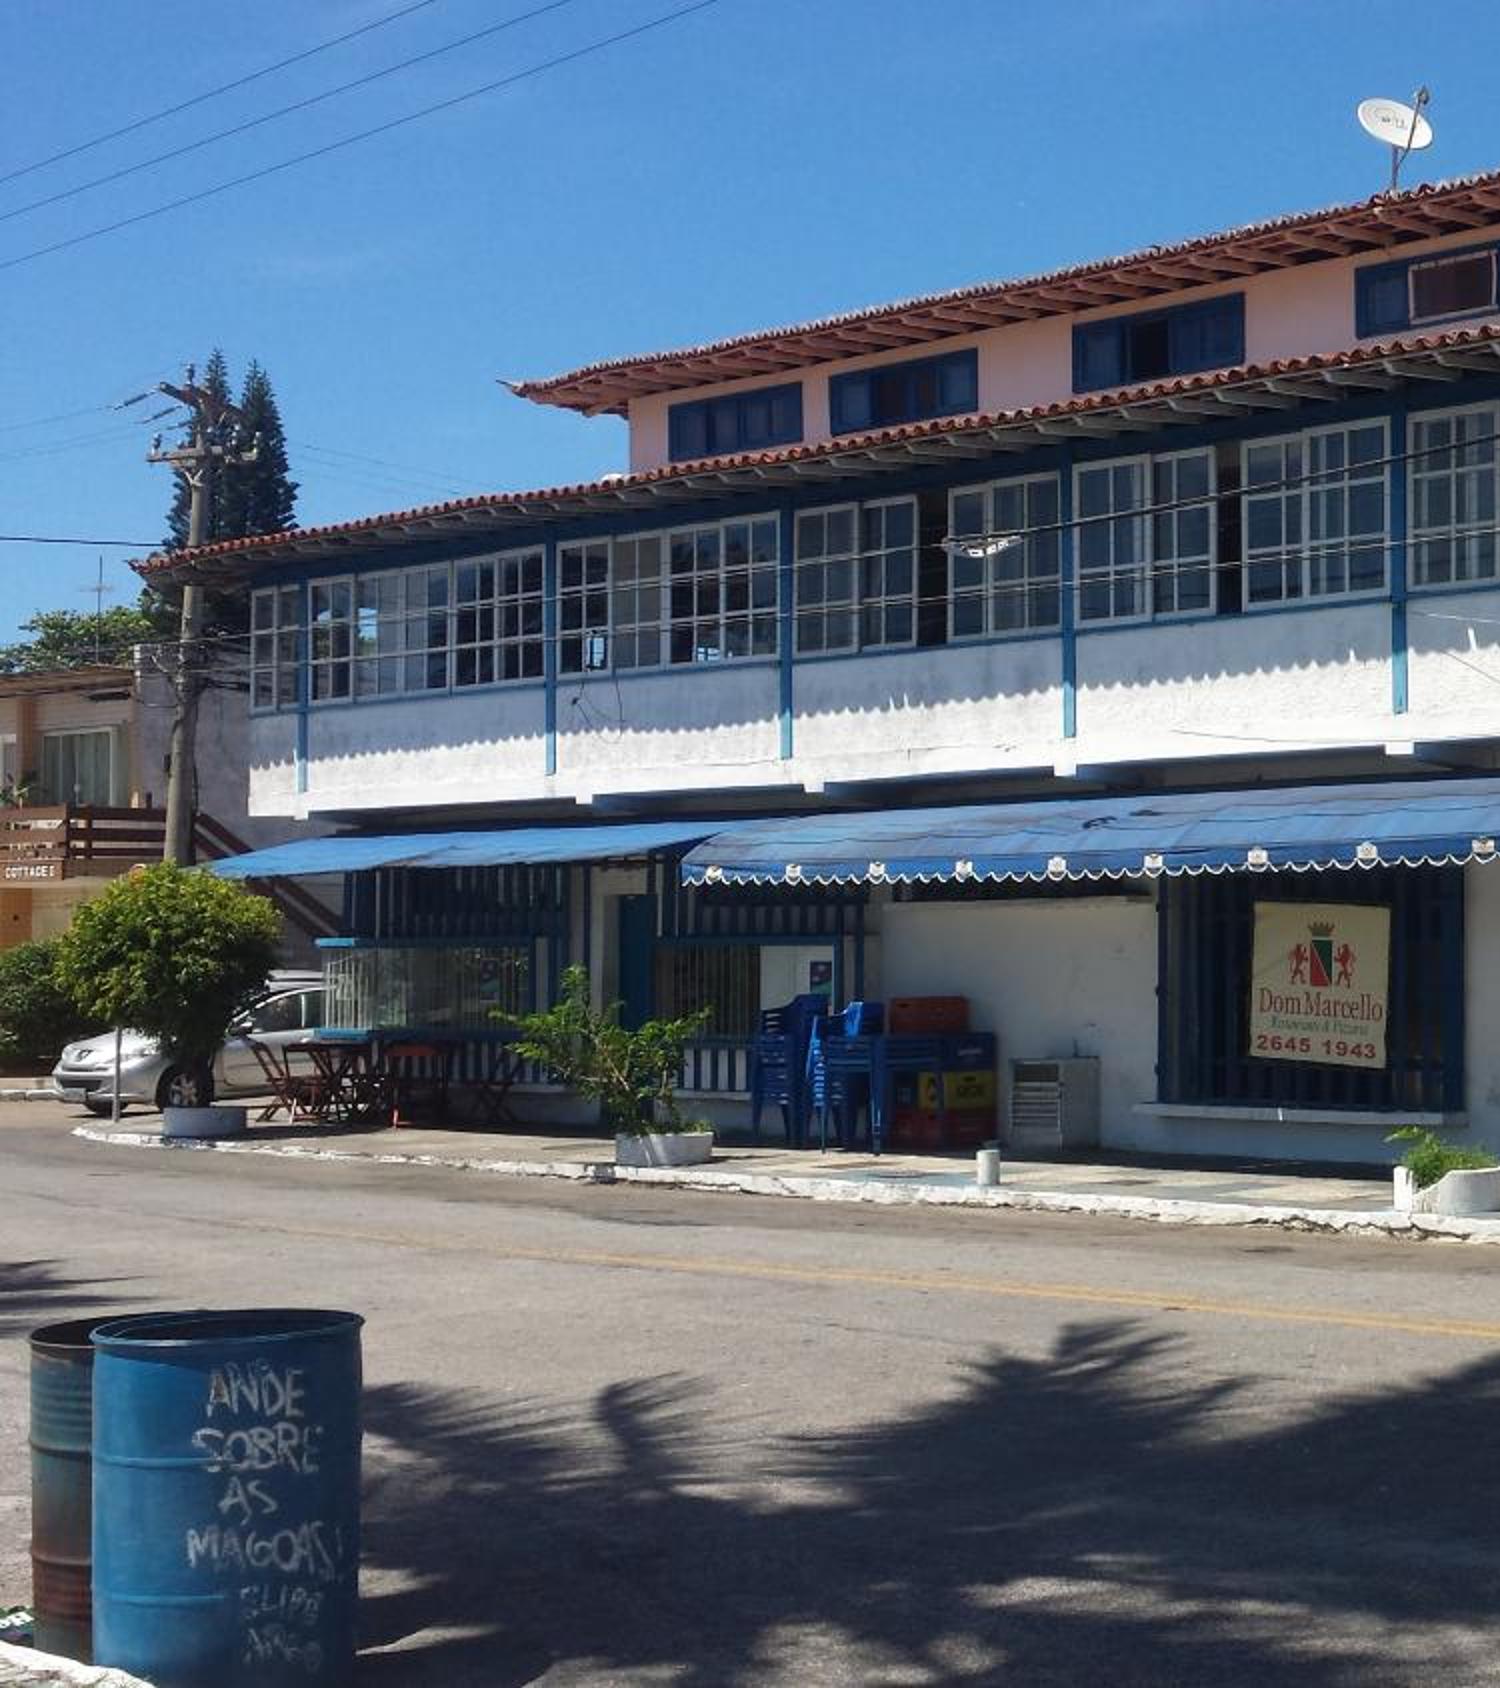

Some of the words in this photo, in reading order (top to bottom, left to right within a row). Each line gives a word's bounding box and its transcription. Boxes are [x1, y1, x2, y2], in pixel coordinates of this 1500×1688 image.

[1256, 1034, 1312, 1053] 2645
[1321, 1039, 1377, 1059] 1943
[206, 1361, 305, 1418] ANDE
[192, 1421, 325, 1474] SOBRE
[217, 1475, 278, 1527] AS
